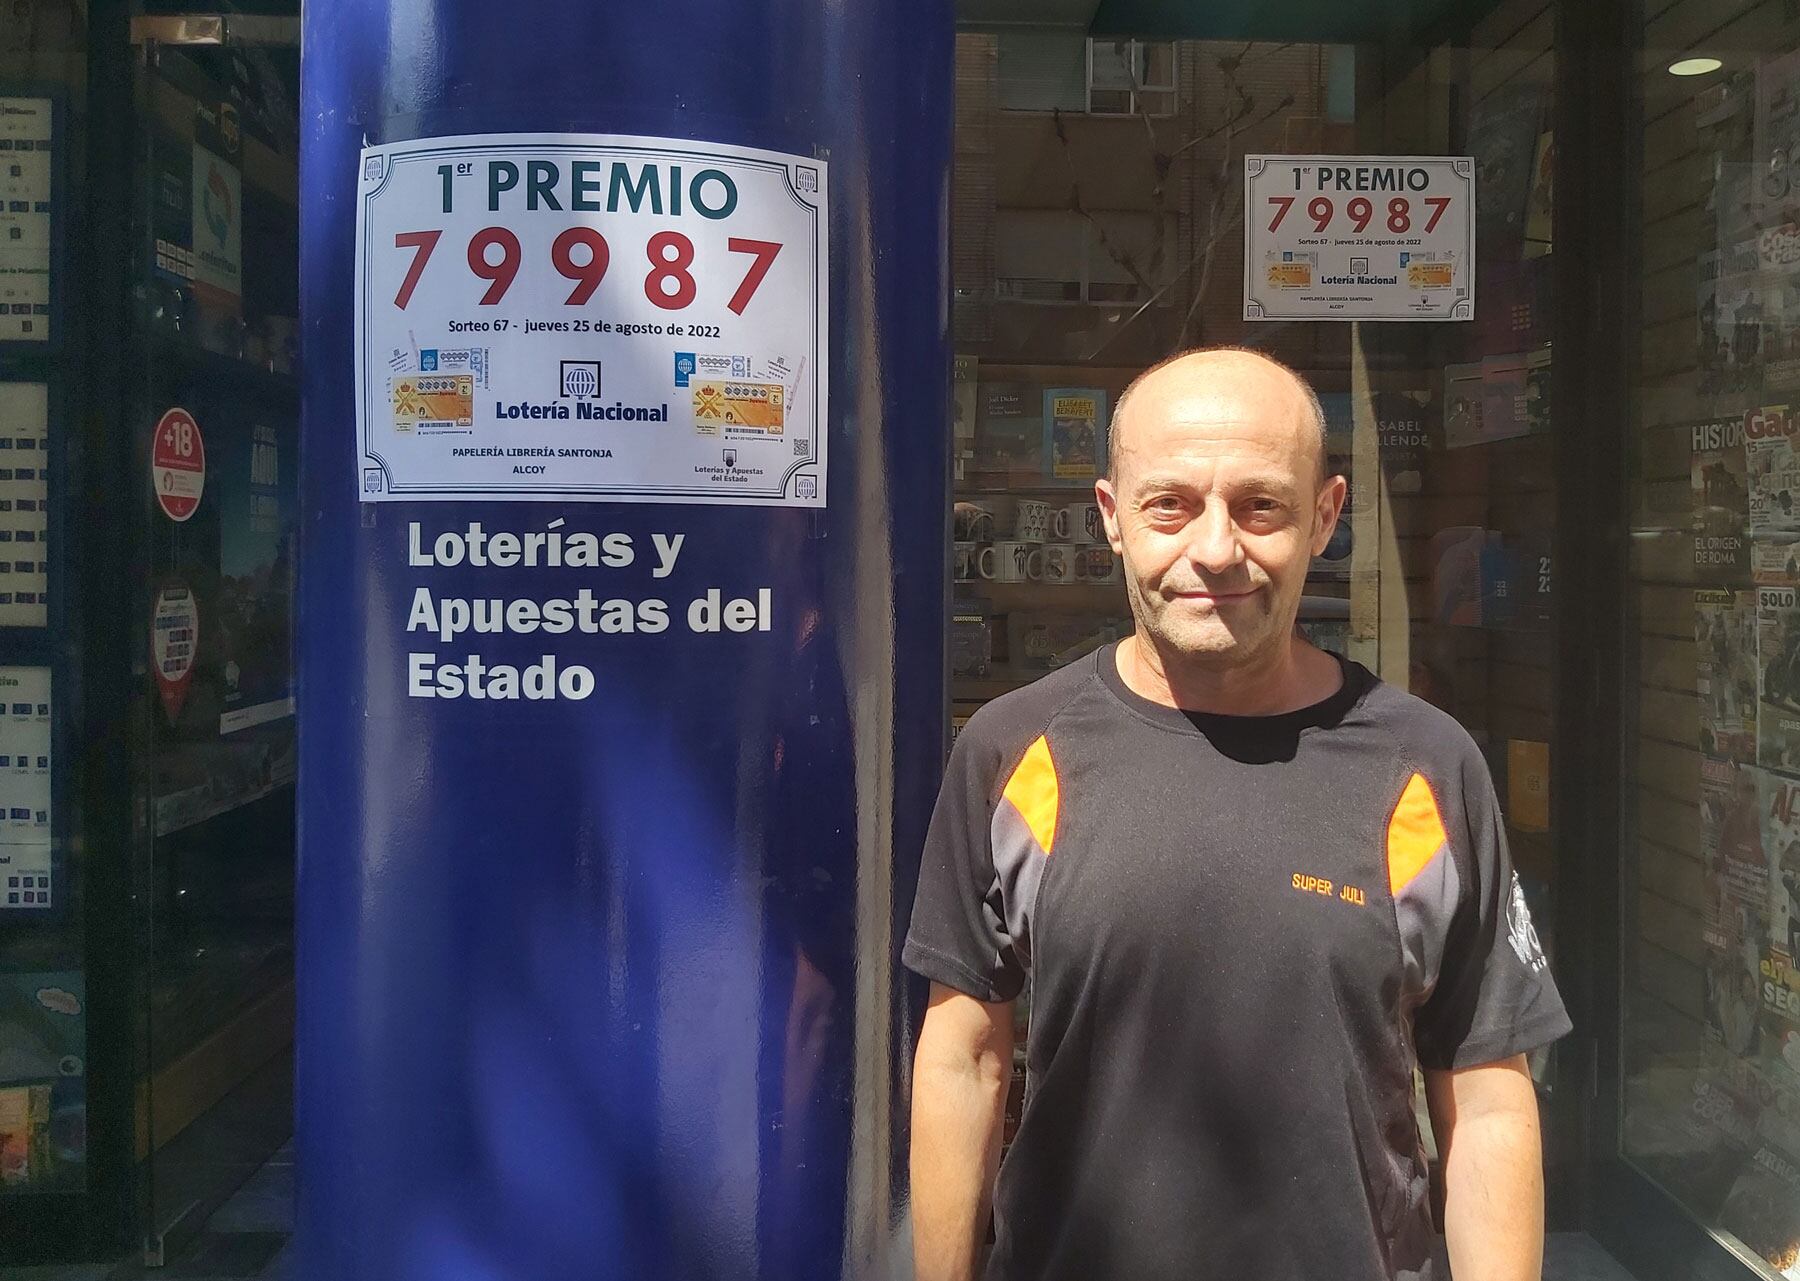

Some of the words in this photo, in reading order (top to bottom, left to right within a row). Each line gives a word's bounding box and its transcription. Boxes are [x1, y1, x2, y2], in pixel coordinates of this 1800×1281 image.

[1317, 167, 1430, 192] PREMIO
[488, 160, 739, 220] PREMIO
[1267, 197, 1452, 235] 79987
[1298, 238, 1318, 246] Sorteo
[1334, 238, 1355, 247] jueves
[1365, 238, 1373, 246] de
[1374, 239, 1395, 248] agosto
[1396, 238, 1405, 246] de
[392, 226, 785, 317] 79987
[1321, 275, 1355, 285] Lotería
[1357, 275, 1398, 286] Nacional
[448, 319, 489, 334] Sorteo
[493, 319, 510, 333] 67
[524, 319, 570, 336] jueves
[573, 320, 591, 333] 25
[593, 320, 612, 334] de
[615, 323, 663, 339] agosto
[665, 323, 685, 337] de
[687, 324, 721, 339] 2022
[495, 400, 570, 420] Lotería
[576, 402, 669, 423] Nacional
[164, 420, 193, 457] +18
[452, 445, 504, 457] PAPELERÍA
[506, 446, 556, 458] LIBRERÍA
[558, 448, 613, 458] SANTONJA
[512, 465, 546, 474] ALCOY
[694, 465, 725, 474] Loterías
[726, 467, 730, 475] y
[731, 466, 764, 477] Apuestas
[711, 474, 723, 482] del
[724, 474, 748, 483] Estado
[1750, 498, 1764, 510] 20
[408, 516, 635, 567] Loterías
[651, 533, 686, 578] y
[1695, 538, 1707, 549] EL
[1707, 536, 1741, 550] ORIGEN
[1695, 551, 1708, 563] DE
[1708, 552, 1736, 564] ROMA
[1760, 591, 1794, 608] SOLO
[406, 587, 670, 642] Apuestas
[687, 588, 772, 633] del
[408, 652, 596, 701] Estado
[1291, 872, 1333, 897] SUPER
